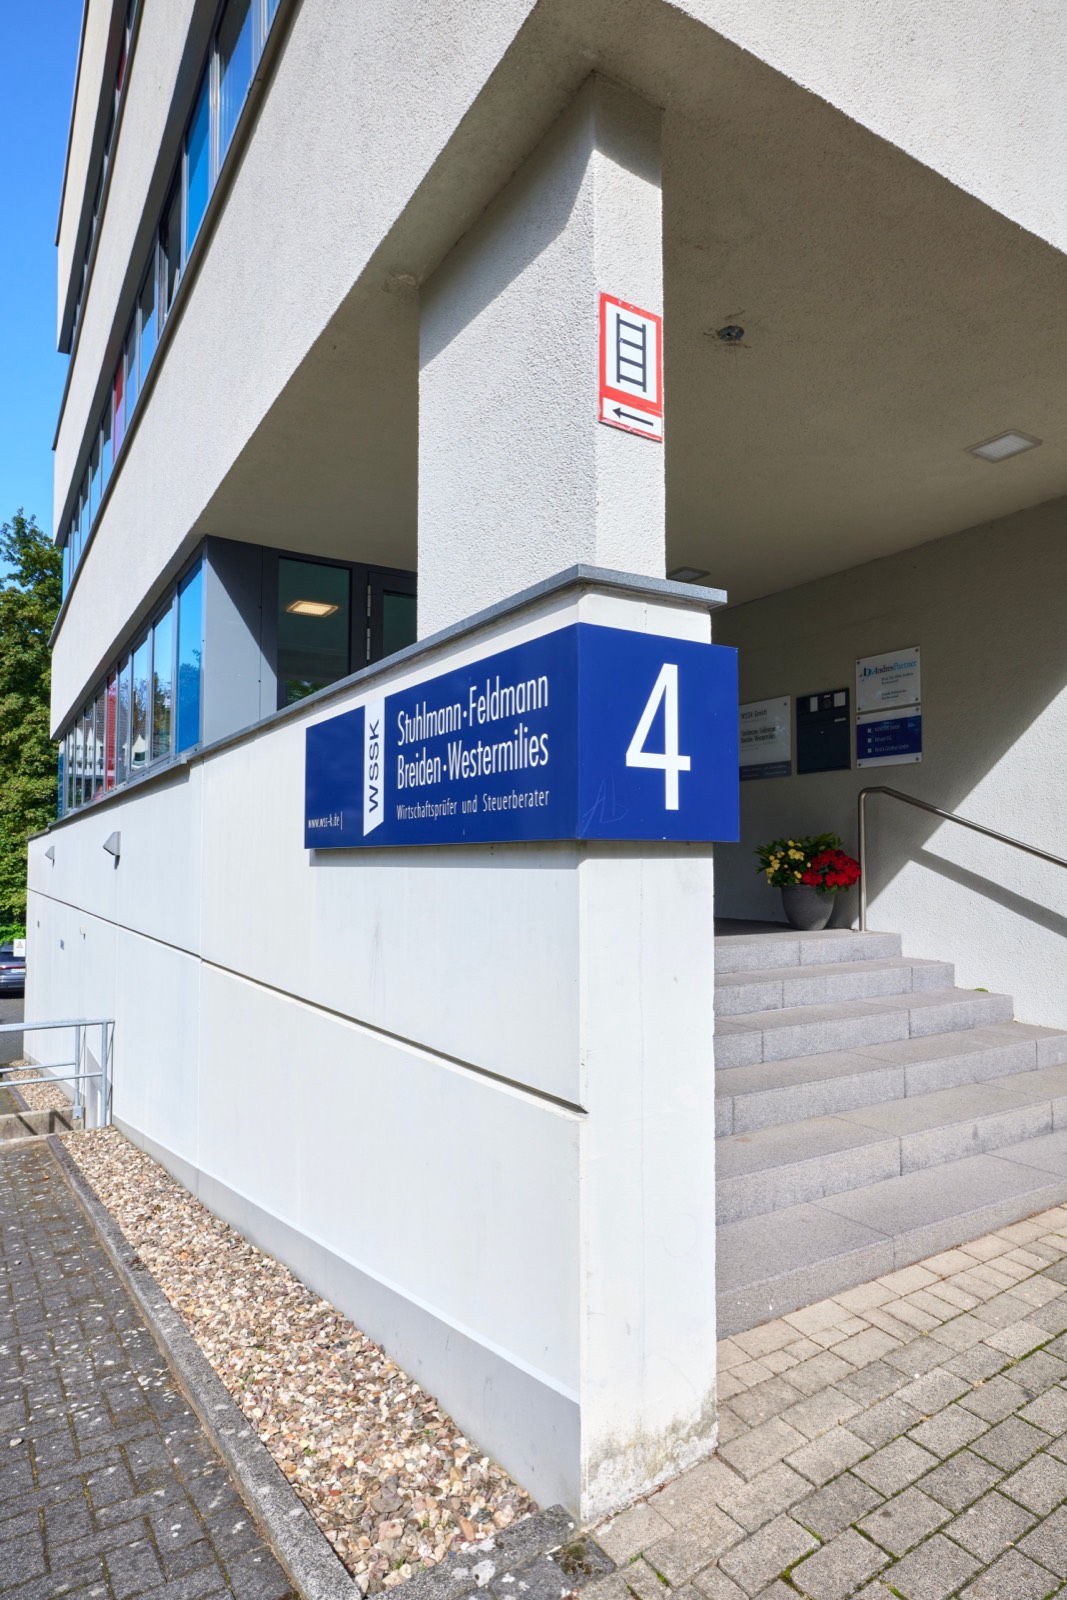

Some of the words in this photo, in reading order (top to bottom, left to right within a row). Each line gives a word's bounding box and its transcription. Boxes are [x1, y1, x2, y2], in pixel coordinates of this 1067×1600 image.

[368, 719, 380, 813] WSSK
[625, 663, 691, 811] 4
[396, 798, 457, 820] Wirtschaftsprüfer
[461, 793, 477, 814] und
[483, 789, 549, 812] Steuerberater
